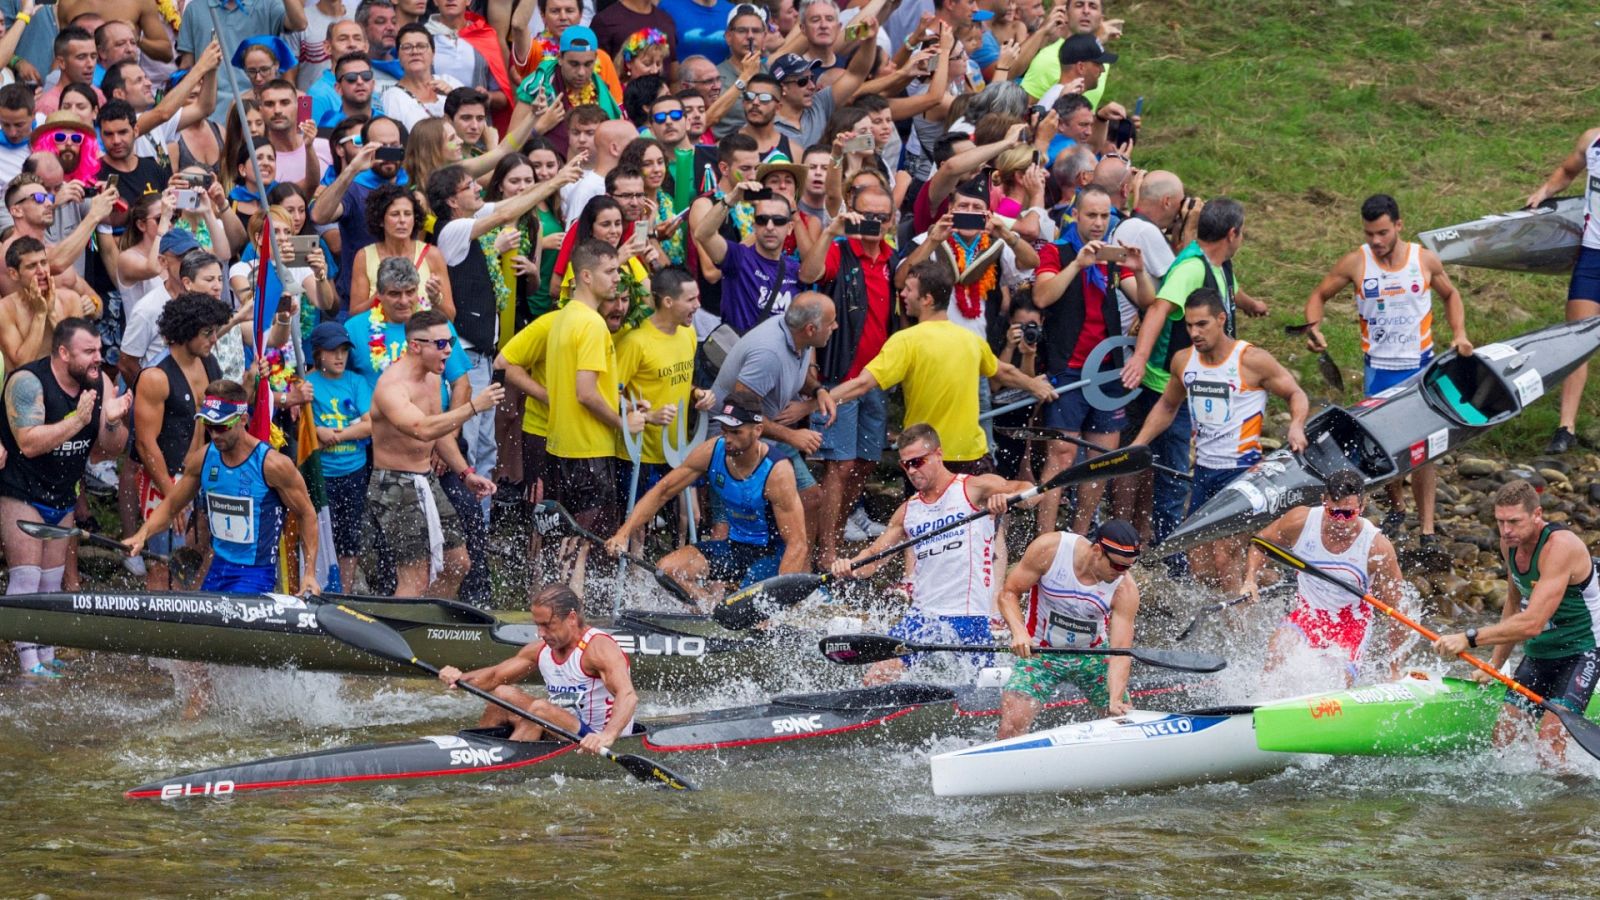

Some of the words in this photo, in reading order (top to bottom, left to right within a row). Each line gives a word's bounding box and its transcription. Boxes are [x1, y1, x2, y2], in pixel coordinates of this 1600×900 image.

[1192, 384, 1226, 394] Liberbank
[1204, 399, 1213, 413] 9
[53, 438, 91, 451] BOX
[211, 499, 245, 513] Liberbank
[224, 516, 232, 531] 1
[917, 540, 963, 561] ELIO
[72, 594, 92, 610] LOS
[148, 598, 213, 614] ARRIONDAS
[1054, 616, 1092, 632] Liberbank
[1066, 632, 1076, 643] 3
[771, 714, 823, 735] SONIC
[1142, 717, 1192, 738] NELO
[449, 746, 503, 767] SONIC
[160, 780, 236, 801] ELIO
